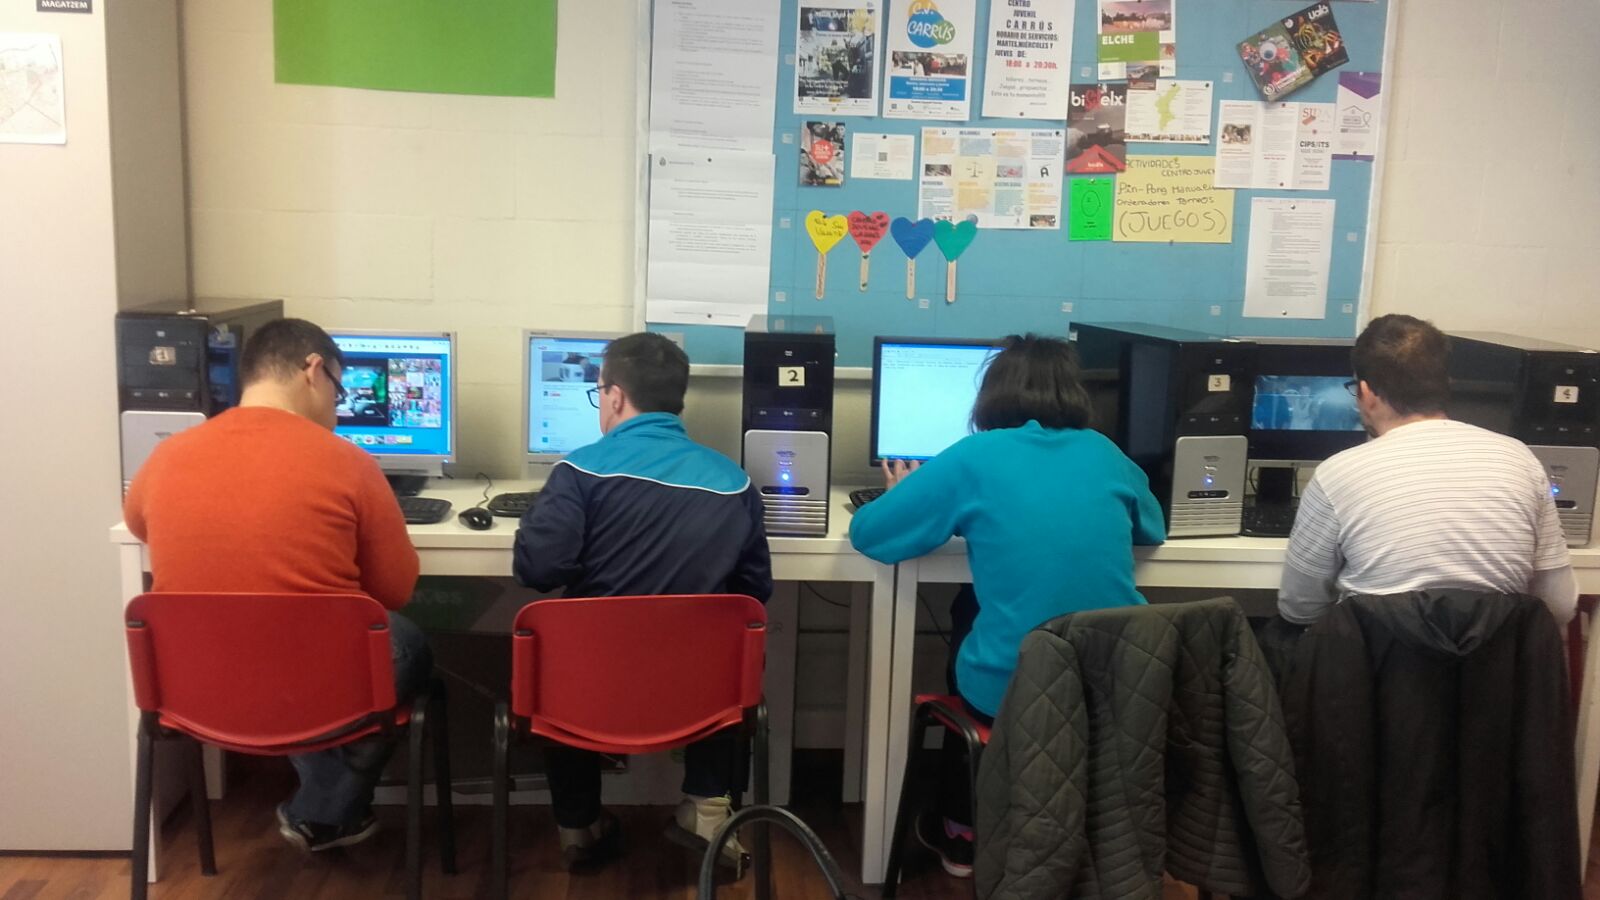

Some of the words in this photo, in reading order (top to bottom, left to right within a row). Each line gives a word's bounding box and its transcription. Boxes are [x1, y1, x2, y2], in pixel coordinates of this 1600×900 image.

[41, 0, 88, 9] MAGATZEM
[1013, 10, 1036, 18] JUVENIL
[996, 31, 1019, 39] HORARIO
[1102, 35, 1134, 45] ELCHE
[787, 369, 799, 382] 2
[1214, 378, 1222, 387] 3
[1563, 389, 1571, 399] 4
